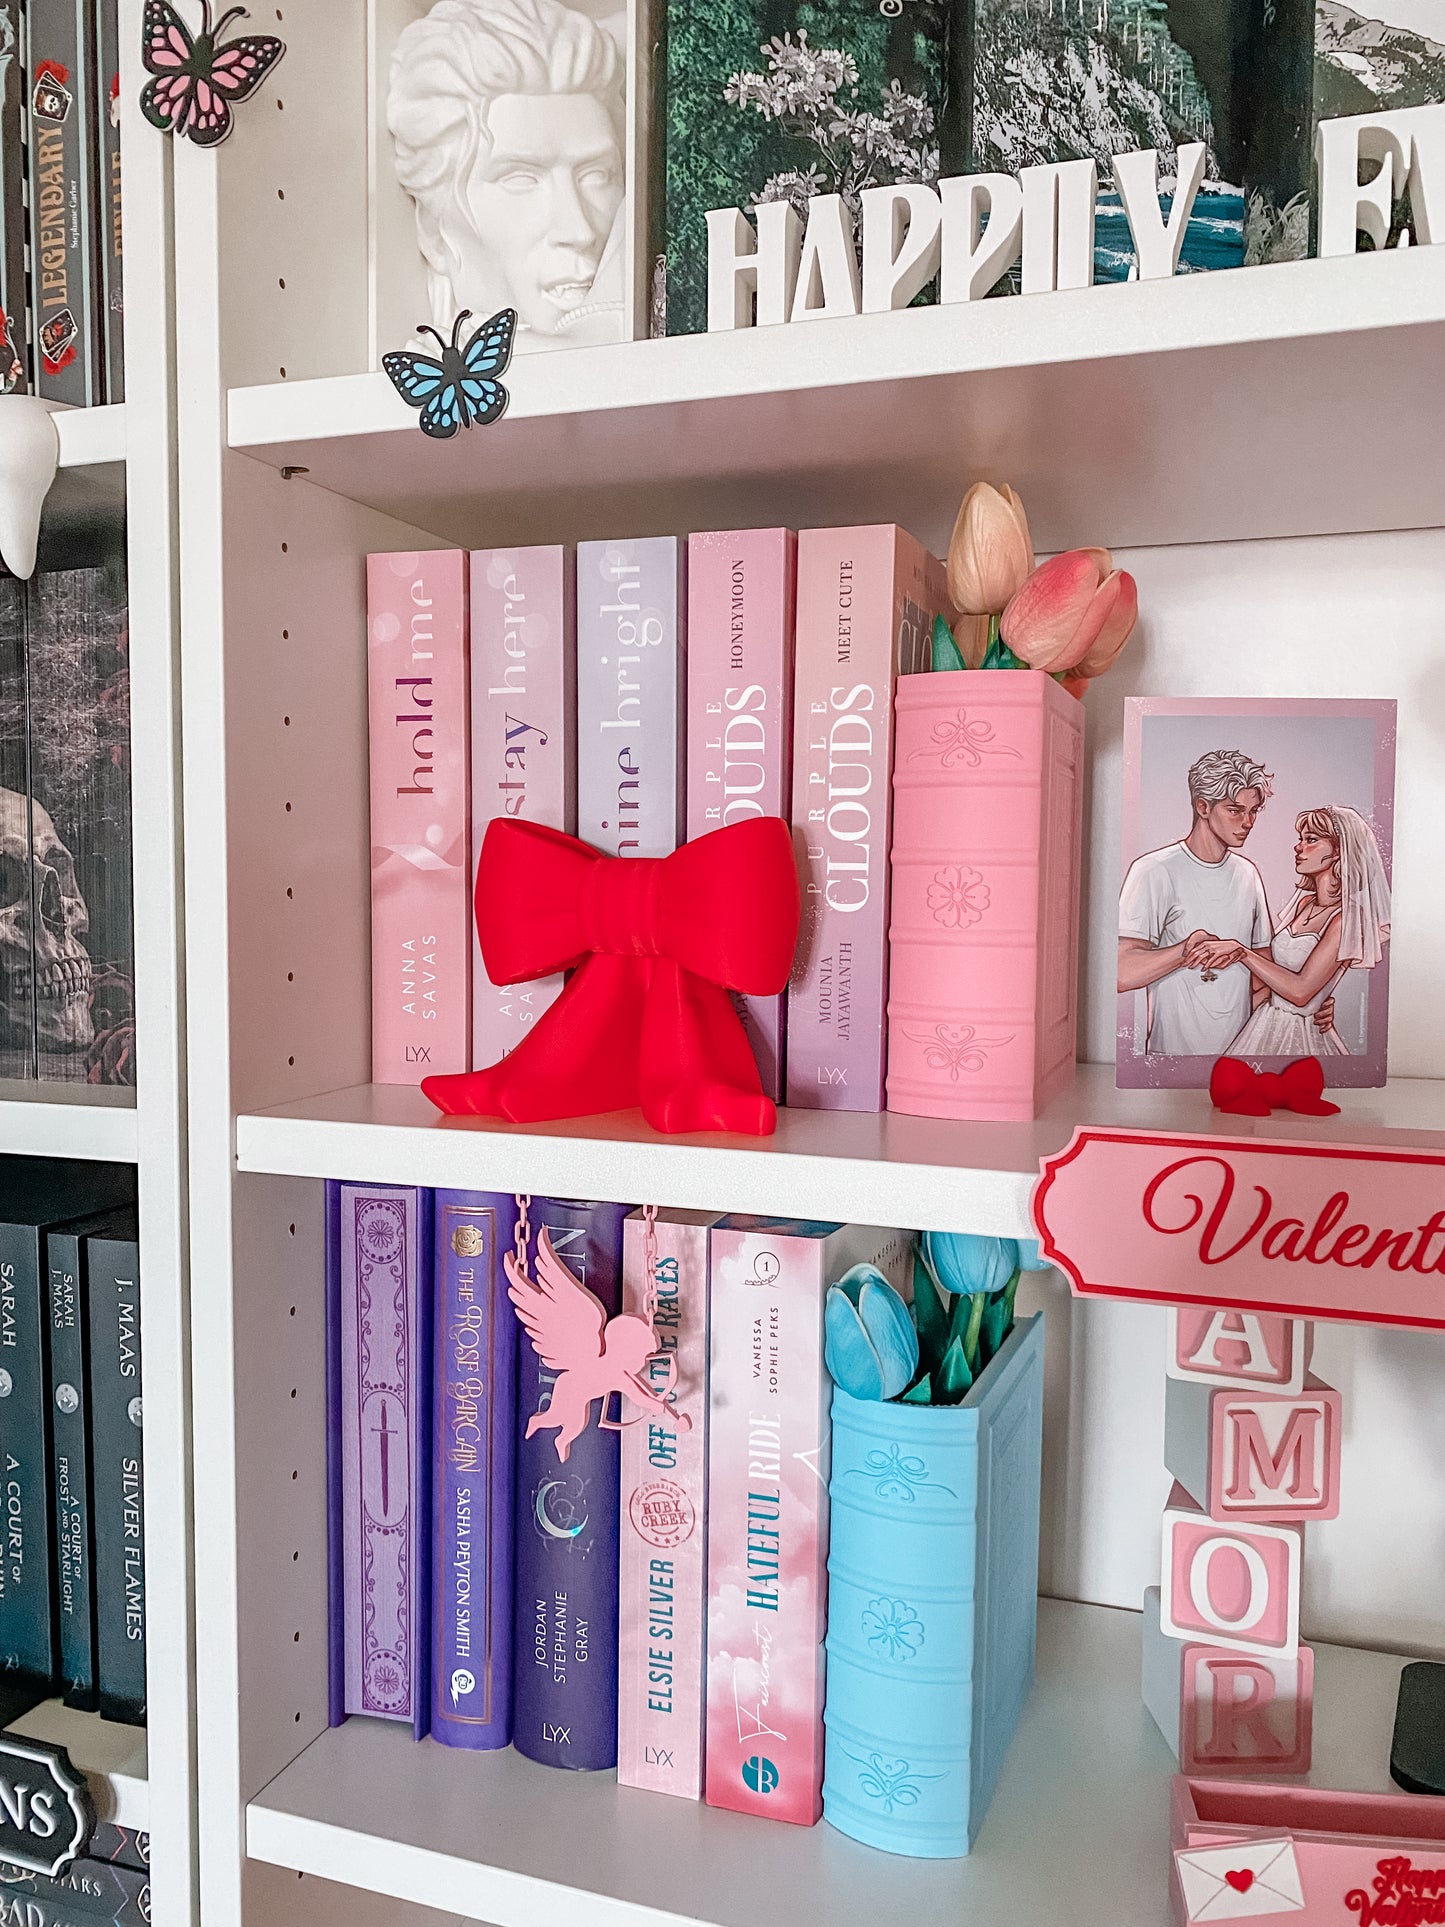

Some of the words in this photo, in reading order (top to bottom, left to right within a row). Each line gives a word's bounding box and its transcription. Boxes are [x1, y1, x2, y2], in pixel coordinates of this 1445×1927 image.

[38, 127, 67, 308] LEGENDARY
[731, 560, 744, 669] HONEYMOON
[839, 560, 853, 608] CUTE
[410, 579, 433, 664] me
[488, 574, 526, 699] here
[600, 557, 663, 733] bright
[838, 614, 852, 663] MEET
[395, 677, 435, 799] hold
[498, 711, 549, 816] stay
[806, 701, 827, 894] PURPLE
[825, 683, 875, 913] CLOUDS
[402, 940, 416, 1014] ANNA
[422, 935, 436, 1020] SAVAS
[819, 956, 833, 1024] MOUNIA
[837, 942, 852, 1040] JAYAWANTH
[405, 1046, 431, 1062] LYX
[817, 1067, 848, 1086] LYX
[52, 1269, 62, 1279] J.
[115, 1277, 133, 1293] J.
[458, 1268, 474, 1302] THE
[763, 1261, 769, 1272] 1
[0, 1262, 17, 1347] SARAH
[53, 1284, 64, 1329] MAAS
[63, 1274, 74, 1327] SARAH
[770, 1307, 779, 1338] PEKS
[118, 1302, 136, 1377] MAAS
[449, 1305, 482, 1372] ROSE
[753, 1318, 761, 1378] VANESSA
[769, 1346, 778, 1394] SOPHIE
[447, 1377, 483, 1474] BARGAIN
[649, 1424, 677, 1468] OFF
[748, 1411, 781, 1481] RIDE
[6, 1453, 20, 1471] A
[58, 1457, 69, 1504] FROST
[7, 1481, 23, 1564] COURT
[70, 1496, 80, 1507] A
[122, 1457, 140, 1538] SILVER
[456, 1487, 471, 1536] SASHA
[641, 1512, 688, 1527] CREEK
[642, 1499, 681, 1515] RUBY
[70, 1512, 82, 1564] COURT
[746, 1490, 781, 1612] HATEFUL
[61, 1534, 73, 1615] STARLIGHT
[124, 1546, 142, 1641] FLAMES
[454, 1541, 471, 1606] PEYTON
[649, 1559, 674, 1640] SILVER
[455, 1608, 469, 1657] SMITH
[535, 1599, 548, 1668] JORDAN
[553, 1591, 568, 1683] STEPHANIE
[576, 1617, 588, 1662] GRAY
[648, 1648, 673, 1713] ELSIE
[543, 1722, 571, 1745] LYX
[645, 1746, 674, 1768] LYX
